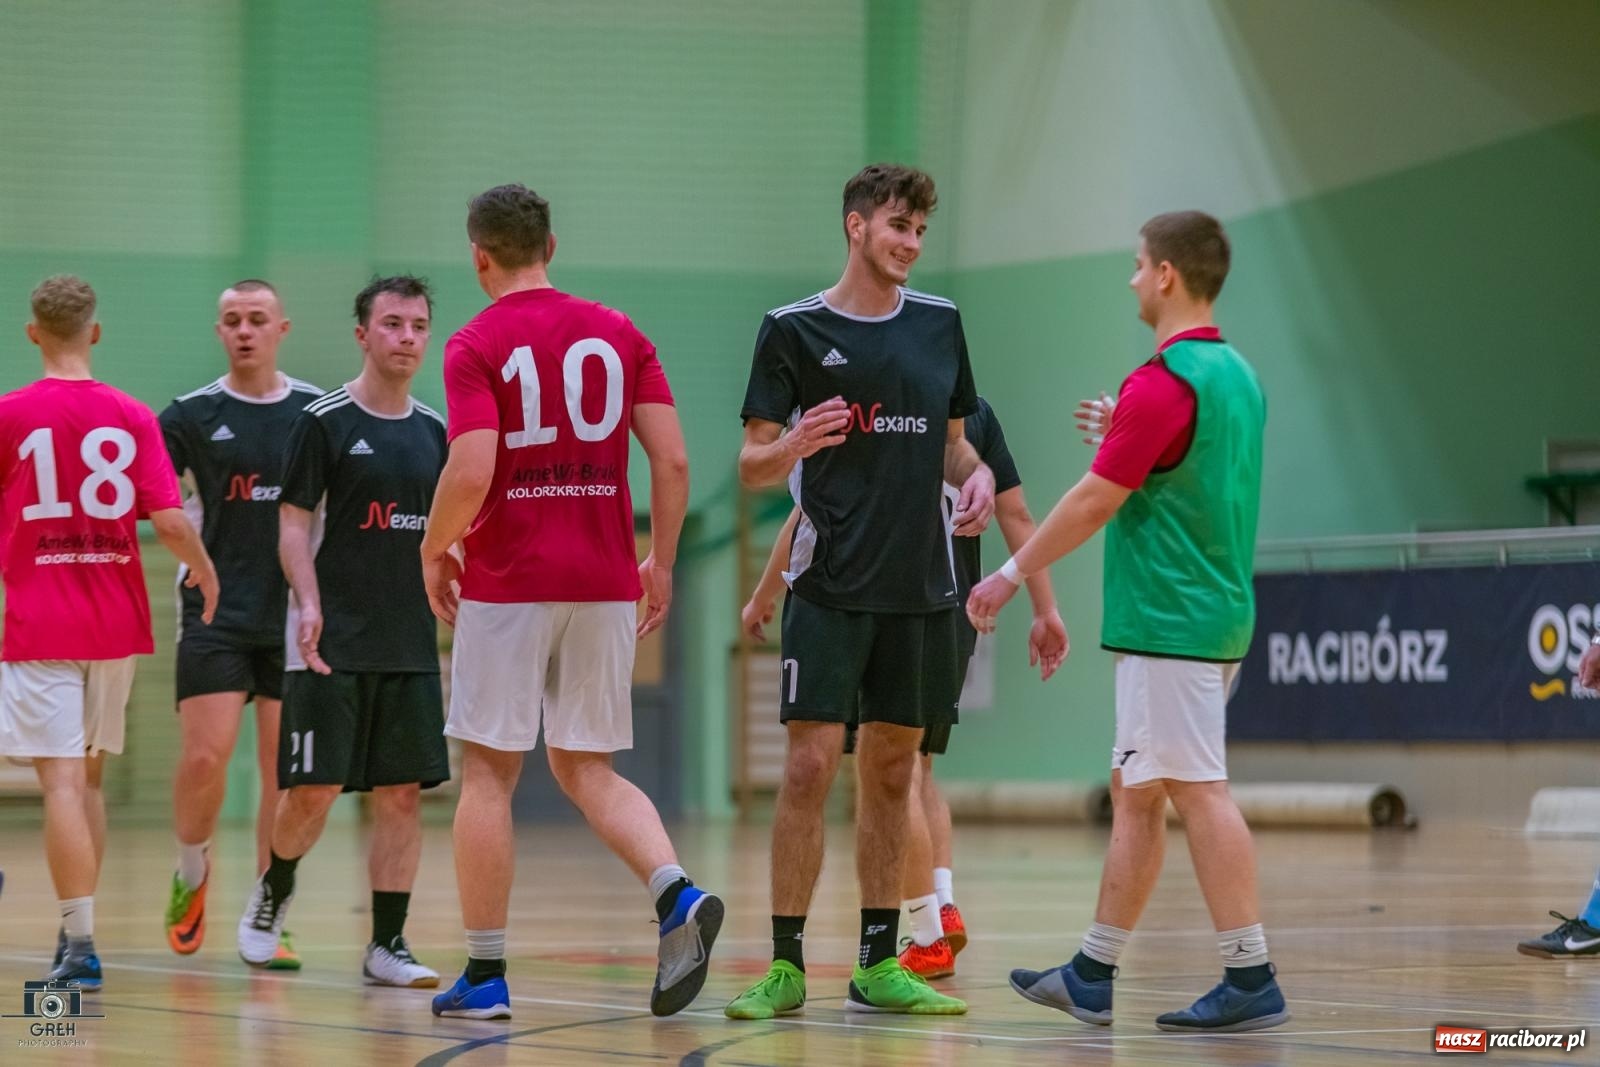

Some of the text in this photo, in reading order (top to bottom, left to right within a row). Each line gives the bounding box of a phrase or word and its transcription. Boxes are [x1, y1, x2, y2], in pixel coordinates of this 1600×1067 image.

[501, 337, 624, 449] 10
[821, 357, 848, 366] adidas
[841, 402, 928, 434] Nexans
[18, 426, 137, 522] 18
[1267, 614, 1448, 685] RACIBÓRZ
